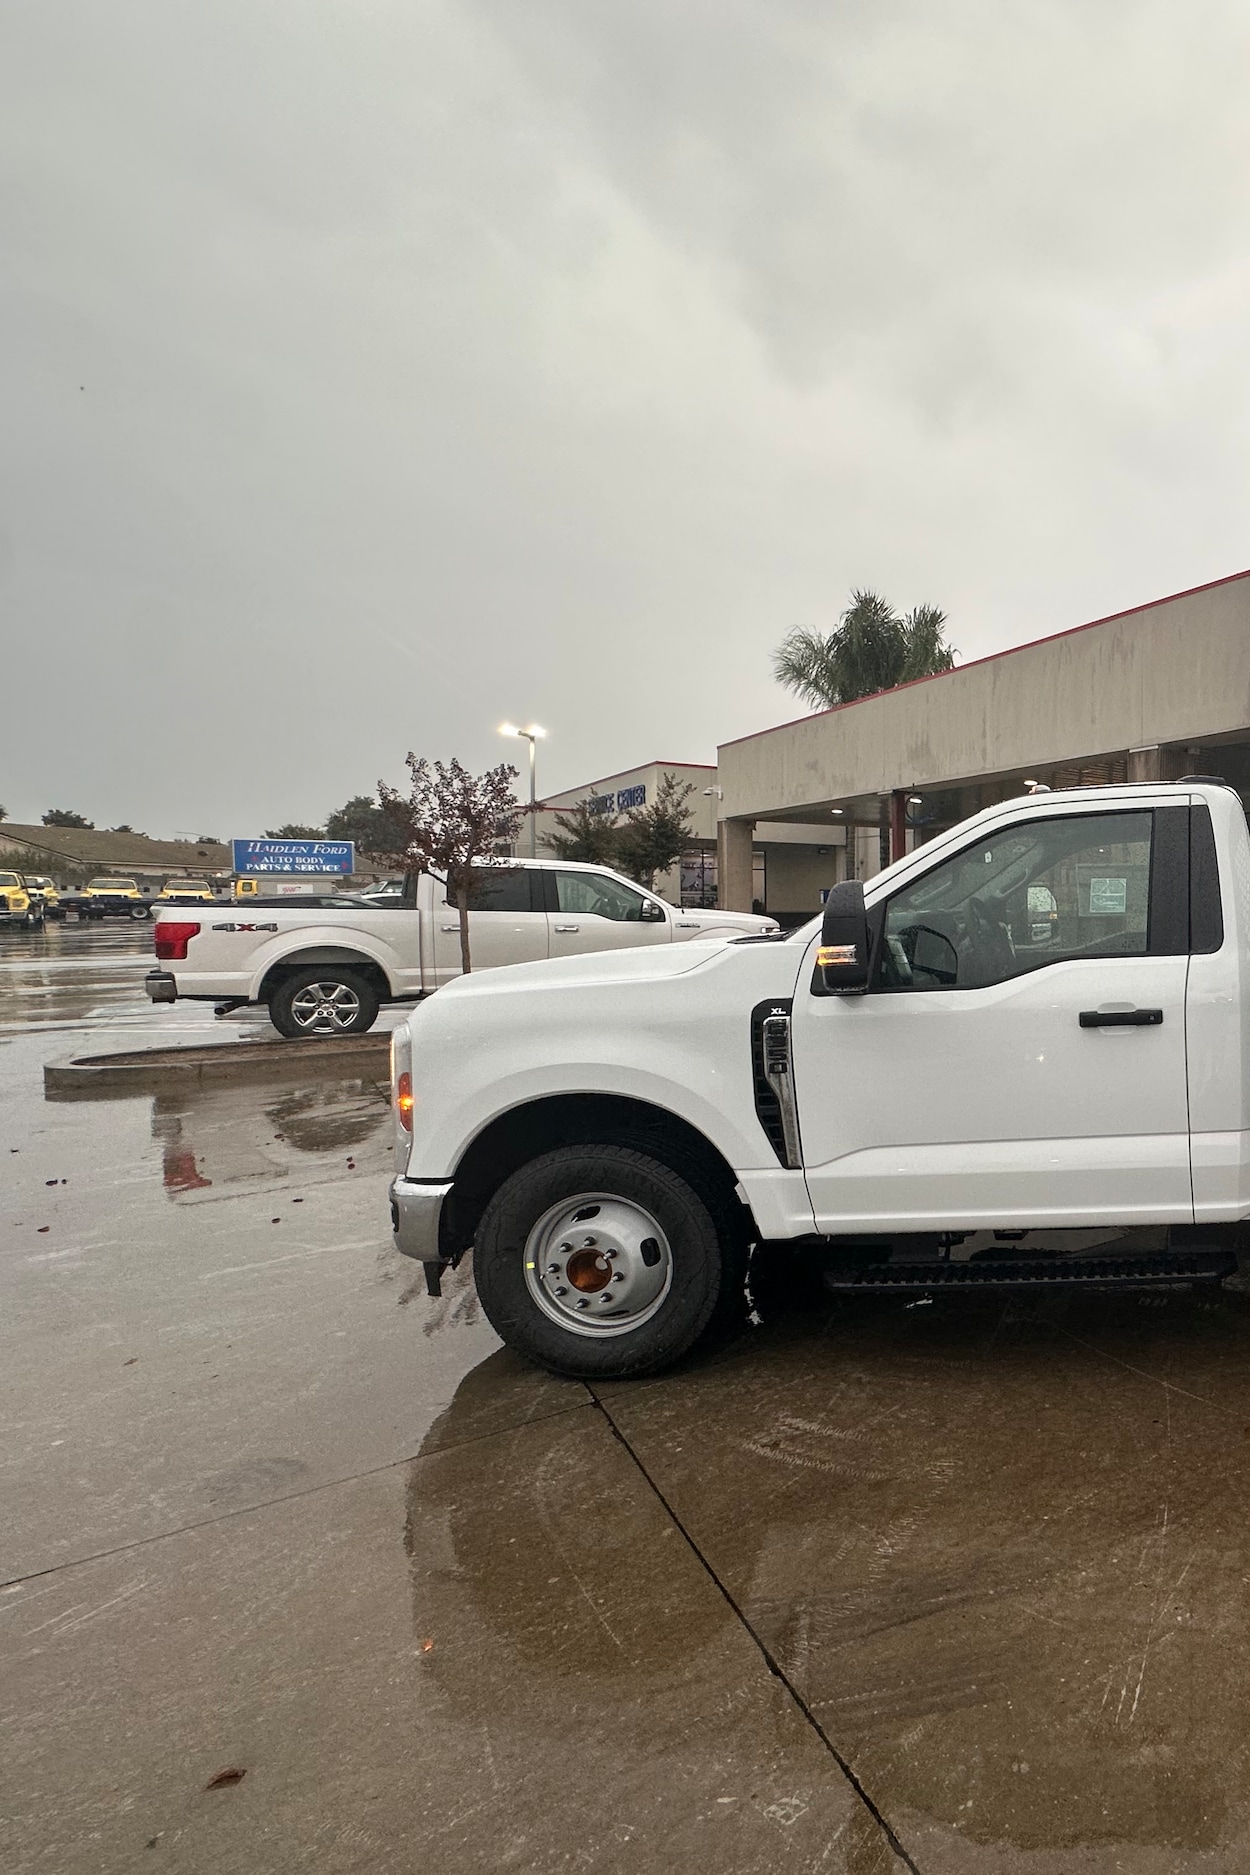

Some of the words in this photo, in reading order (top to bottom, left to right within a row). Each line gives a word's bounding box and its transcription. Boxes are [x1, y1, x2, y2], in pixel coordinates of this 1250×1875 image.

[247, 842, 309, 854] HAIDLEN
[312, 844, 348, 855] FORD
[295, 856, 326, 864] BODY
[246, 863, 280, 871] PARTS
[282, 863, 292, 871] &
[294, 863, 341, 872] SERVICE
[770, 1007, 787, 1015] XL
